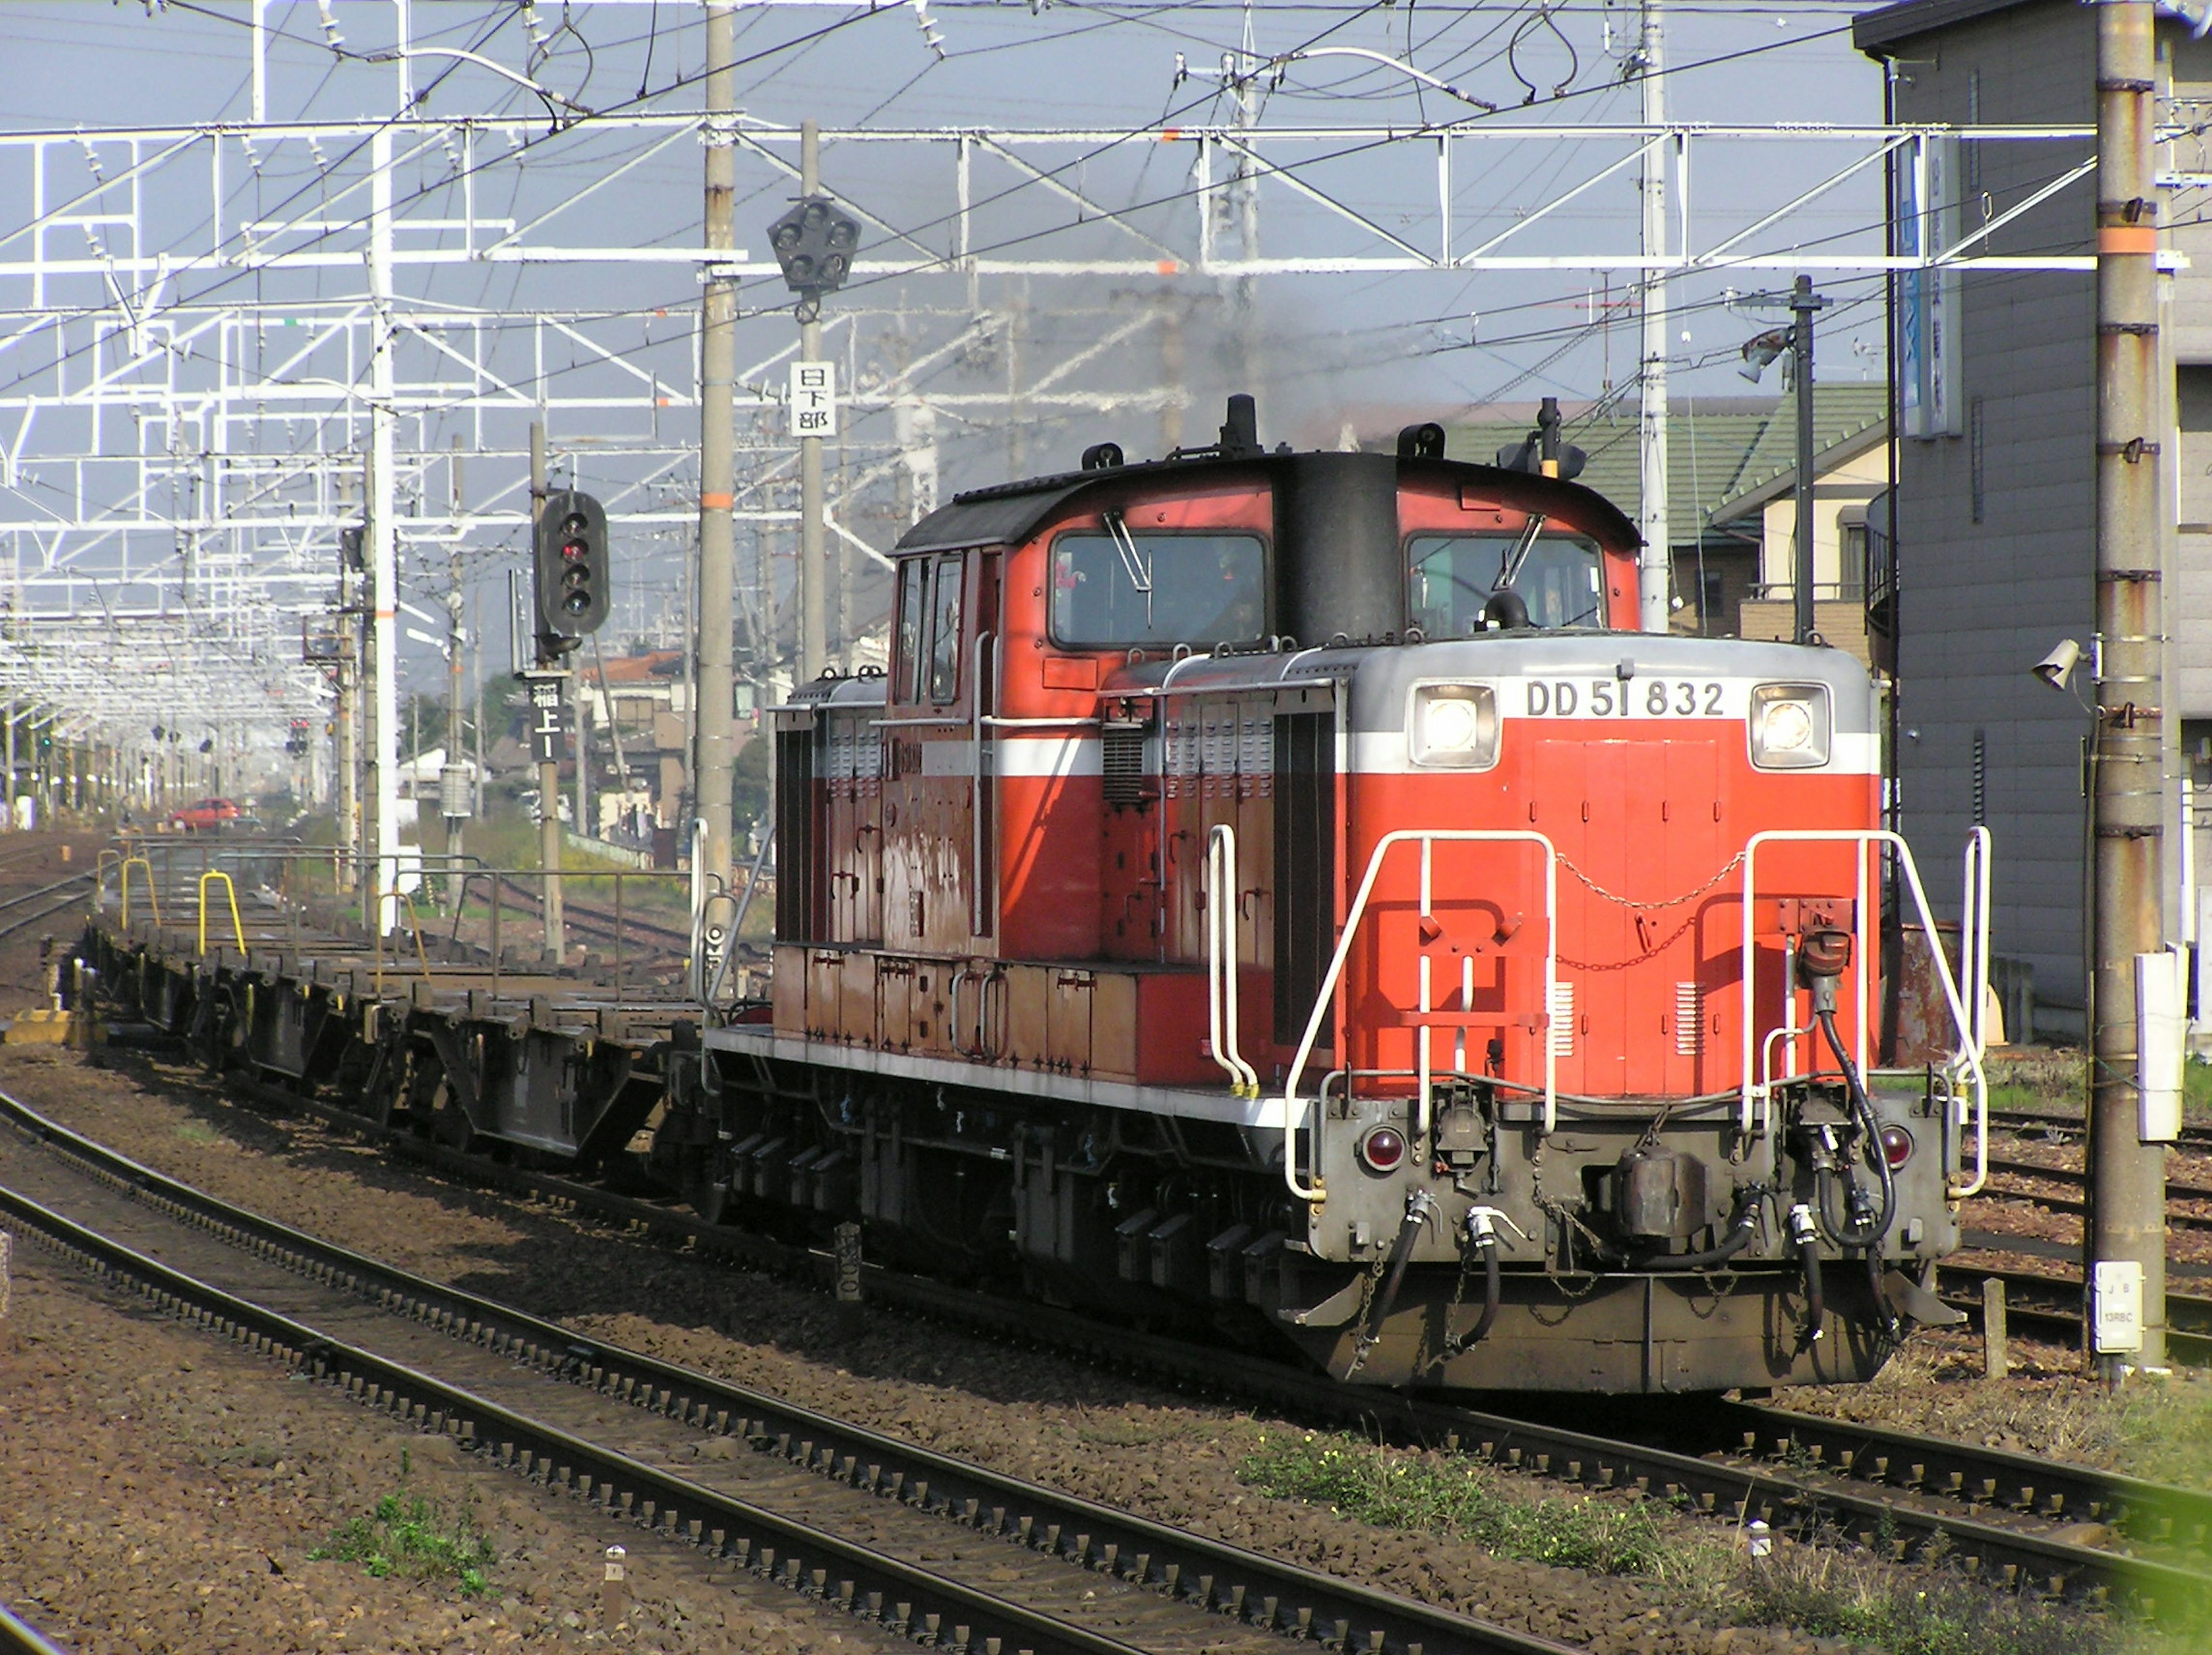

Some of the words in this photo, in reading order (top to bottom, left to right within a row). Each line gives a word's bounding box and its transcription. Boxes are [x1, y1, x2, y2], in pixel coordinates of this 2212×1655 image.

[800, 369, 828, 429] 日下部
[1528, 680, 1628, 716] DD51
[1646, 680, 1724, 715] 832
